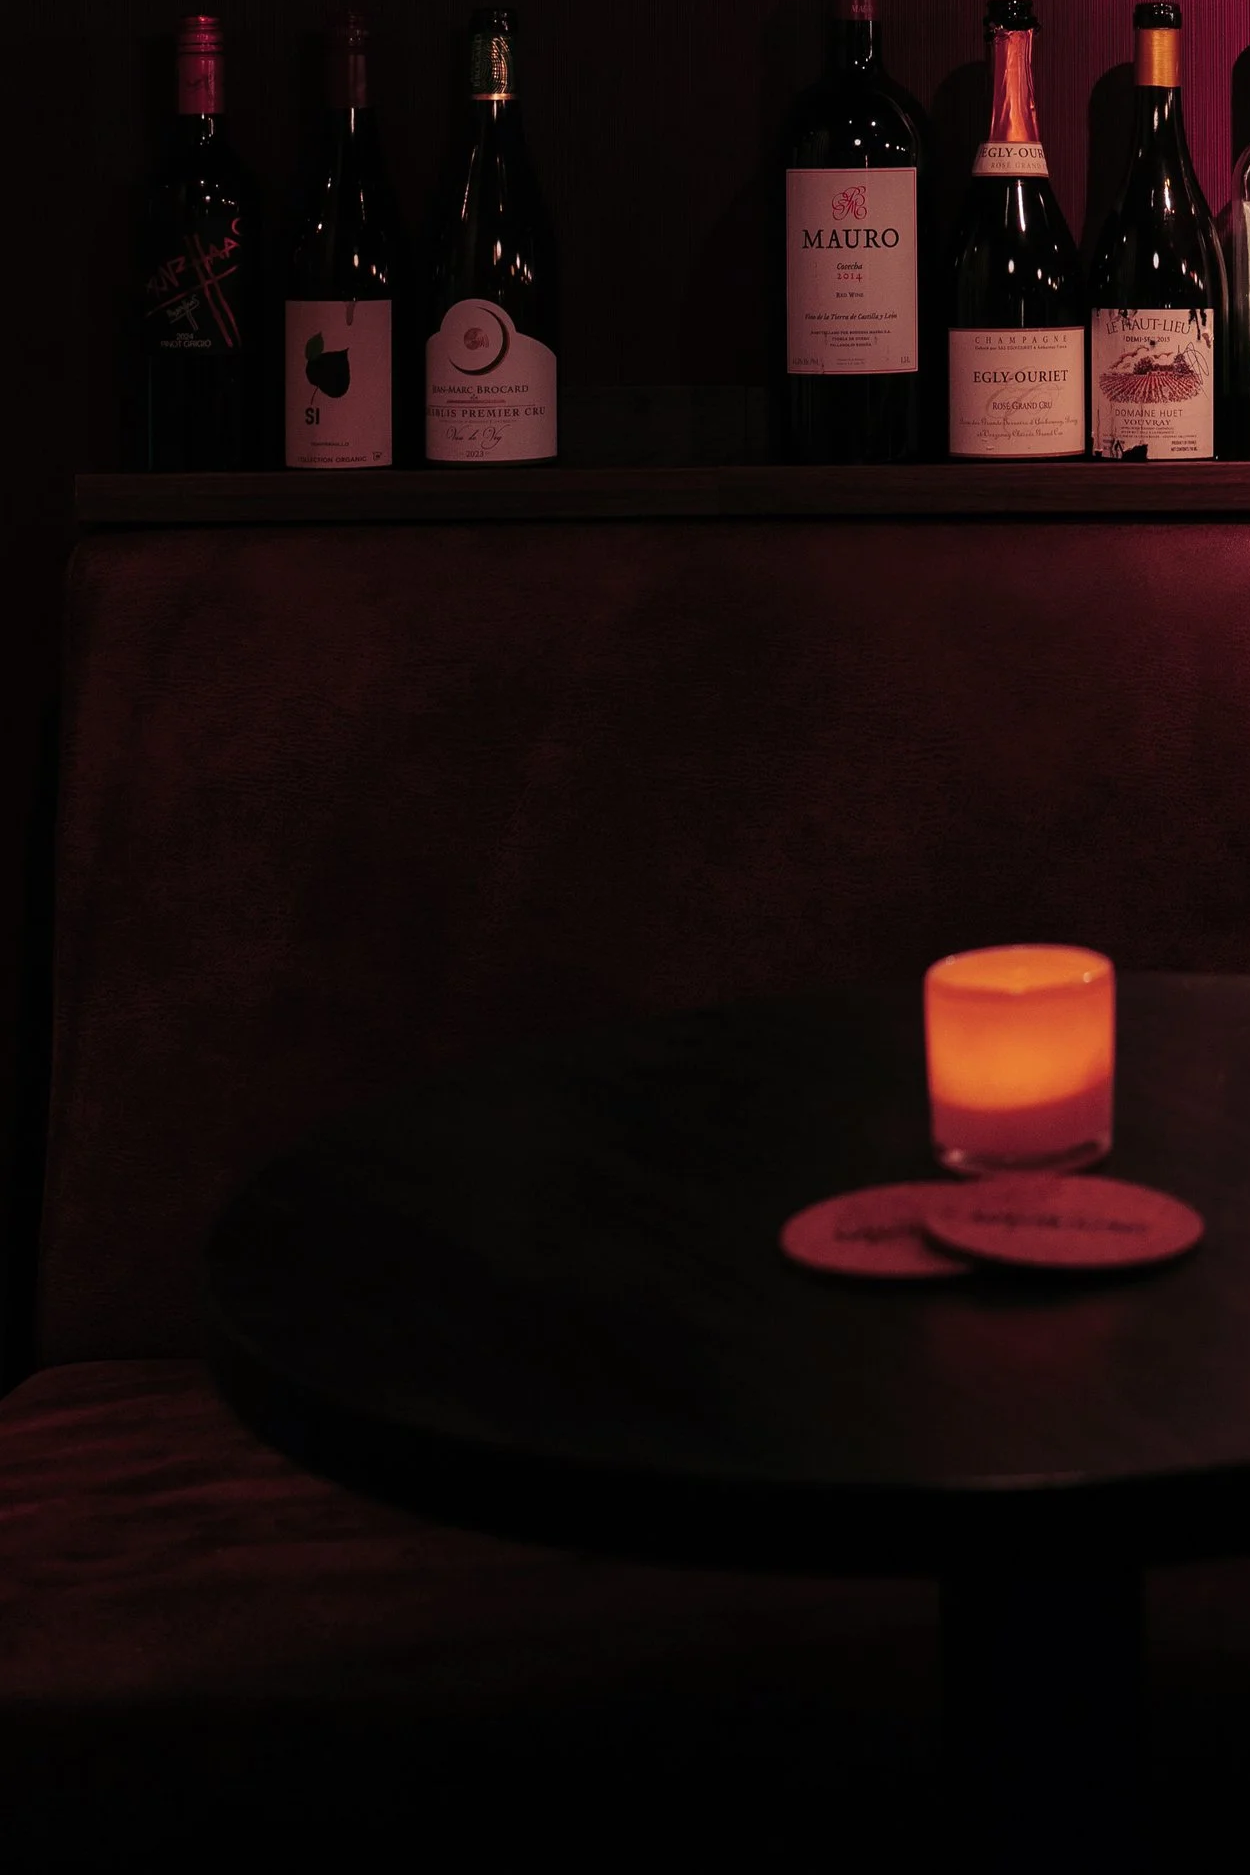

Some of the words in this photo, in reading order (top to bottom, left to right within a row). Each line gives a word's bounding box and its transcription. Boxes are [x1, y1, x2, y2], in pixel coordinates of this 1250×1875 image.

[801, 227, 900, 249] MAURO
[836, 262, 863, 270] Cosecha
[837, 273, 863, 282] 2014
[1105, 321, 1119, 335] LE
[1121, 318, 1191, 335] HAUT-LIEU
[974, 334, 1068, 344] CHAMPAGNE
[972, 369, 1069, 384] EGLY-OURIET
[477, 384, 529, 394] BROCARD
[304, 407, 320, 425] SI
[461, 408, 520, 418] PREMIER
[524, 406, 546, 416] CRU
[1115, 409, 1156, 417] DOMAINE
[1159, 409, 1183, 417] HUET
[1123, 418, 1172, 427] VOUVRAY
